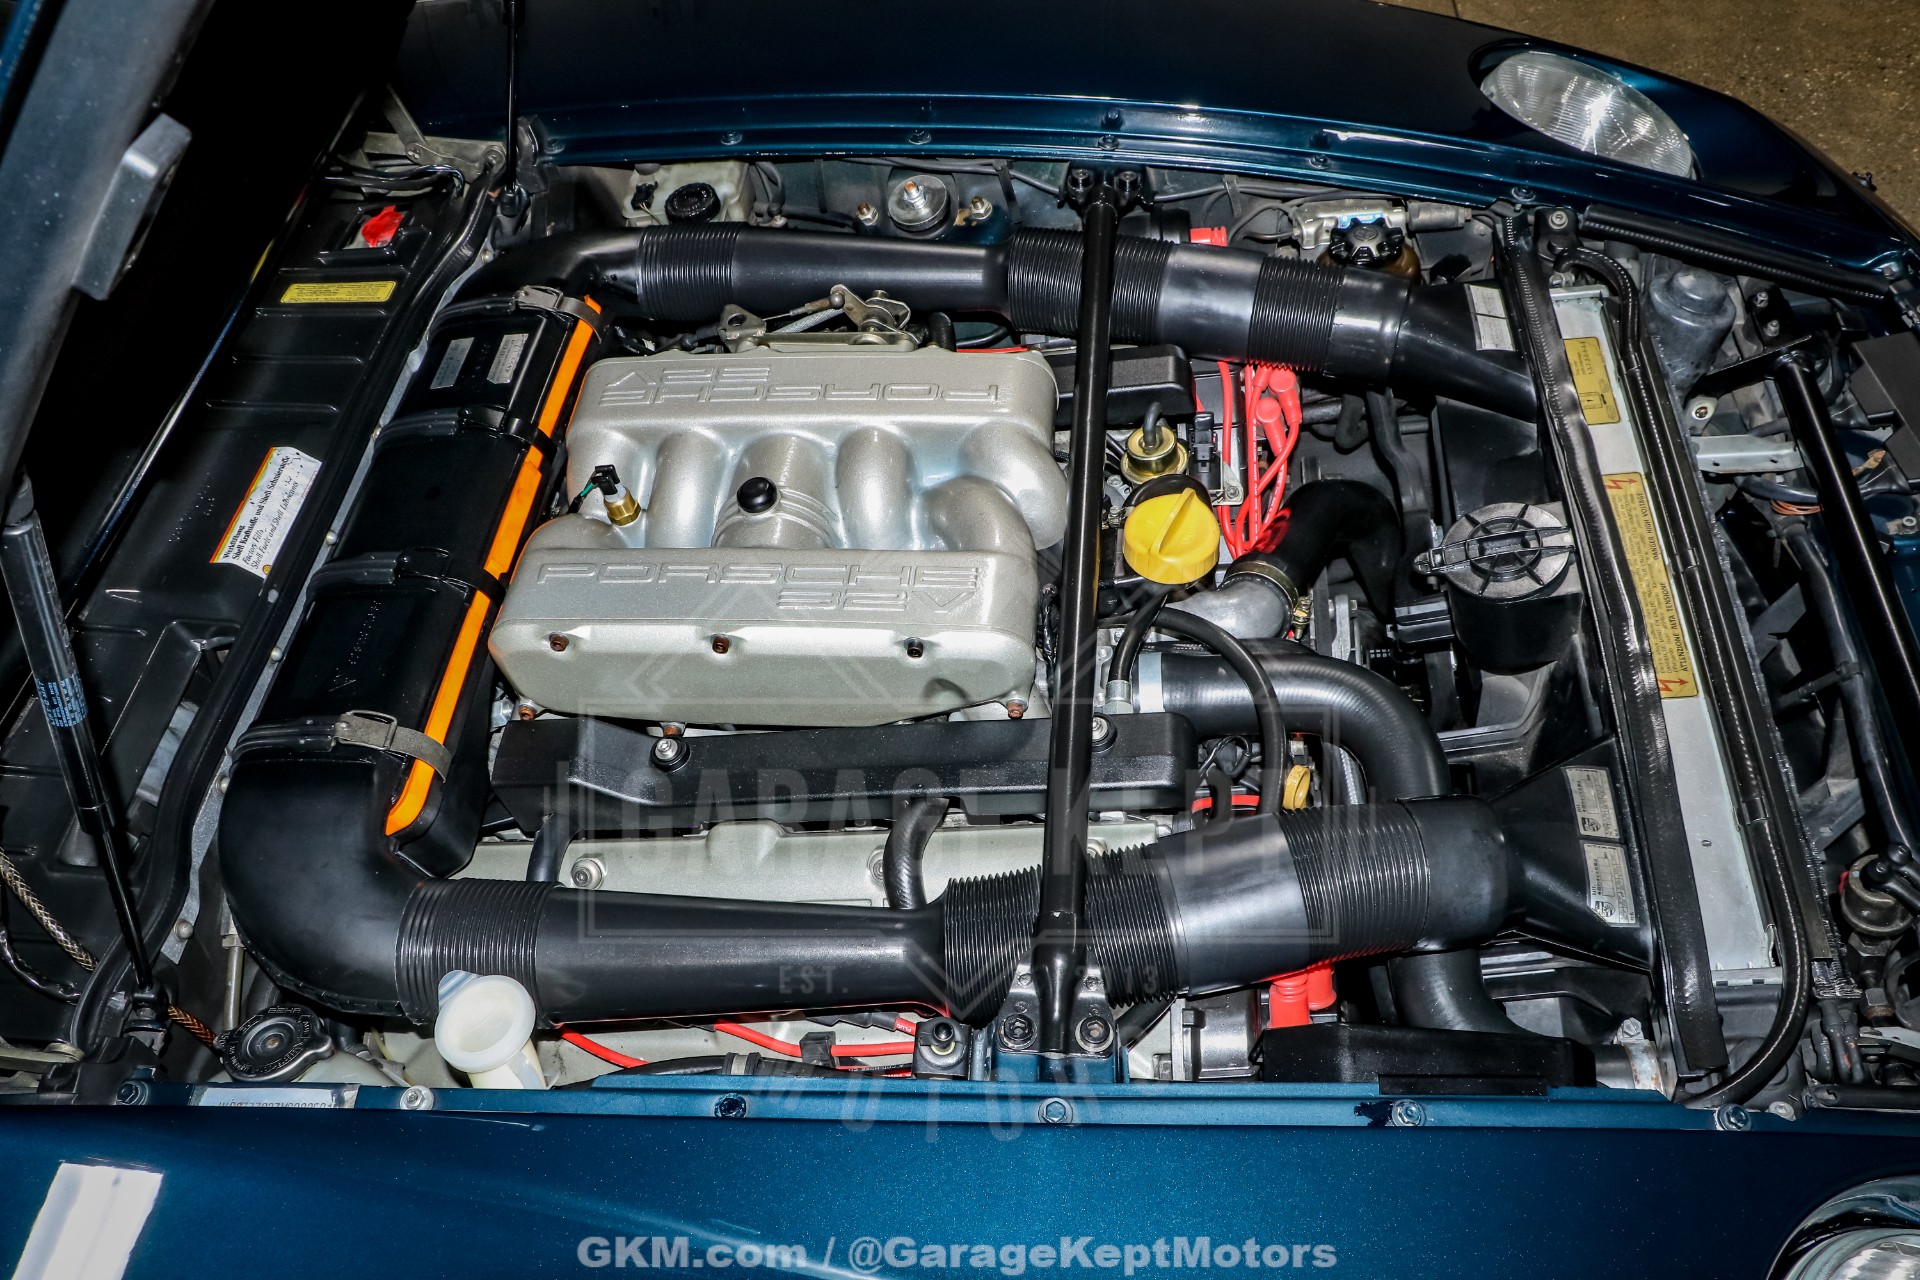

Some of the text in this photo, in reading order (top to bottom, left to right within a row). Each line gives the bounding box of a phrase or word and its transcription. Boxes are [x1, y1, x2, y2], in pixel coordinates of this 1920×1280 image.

[606, 366, 770, 387] 32V
[601, 384, 999, 406] PORSCHE
[272, 509, 284, 526] Shell
[269, 524, 277, 538] and
[232, 541, 244, 560] Shell
[242, 543, 257, 565] Factory
[258, 538, 272, 555] Fuels
[250, 553, 263, 570] Shell
[537, 563, 980, 589] PORSCHE
[1637, 492, 1688, 672] ATTENZIONE ALTA TENSIONE DANGER HIGH VOLTAGE
[777, 588, 976, 614] 32V
[267, 1005, 302, 1014] BEHR
[896, 1023, 912, 1033] PLUG
